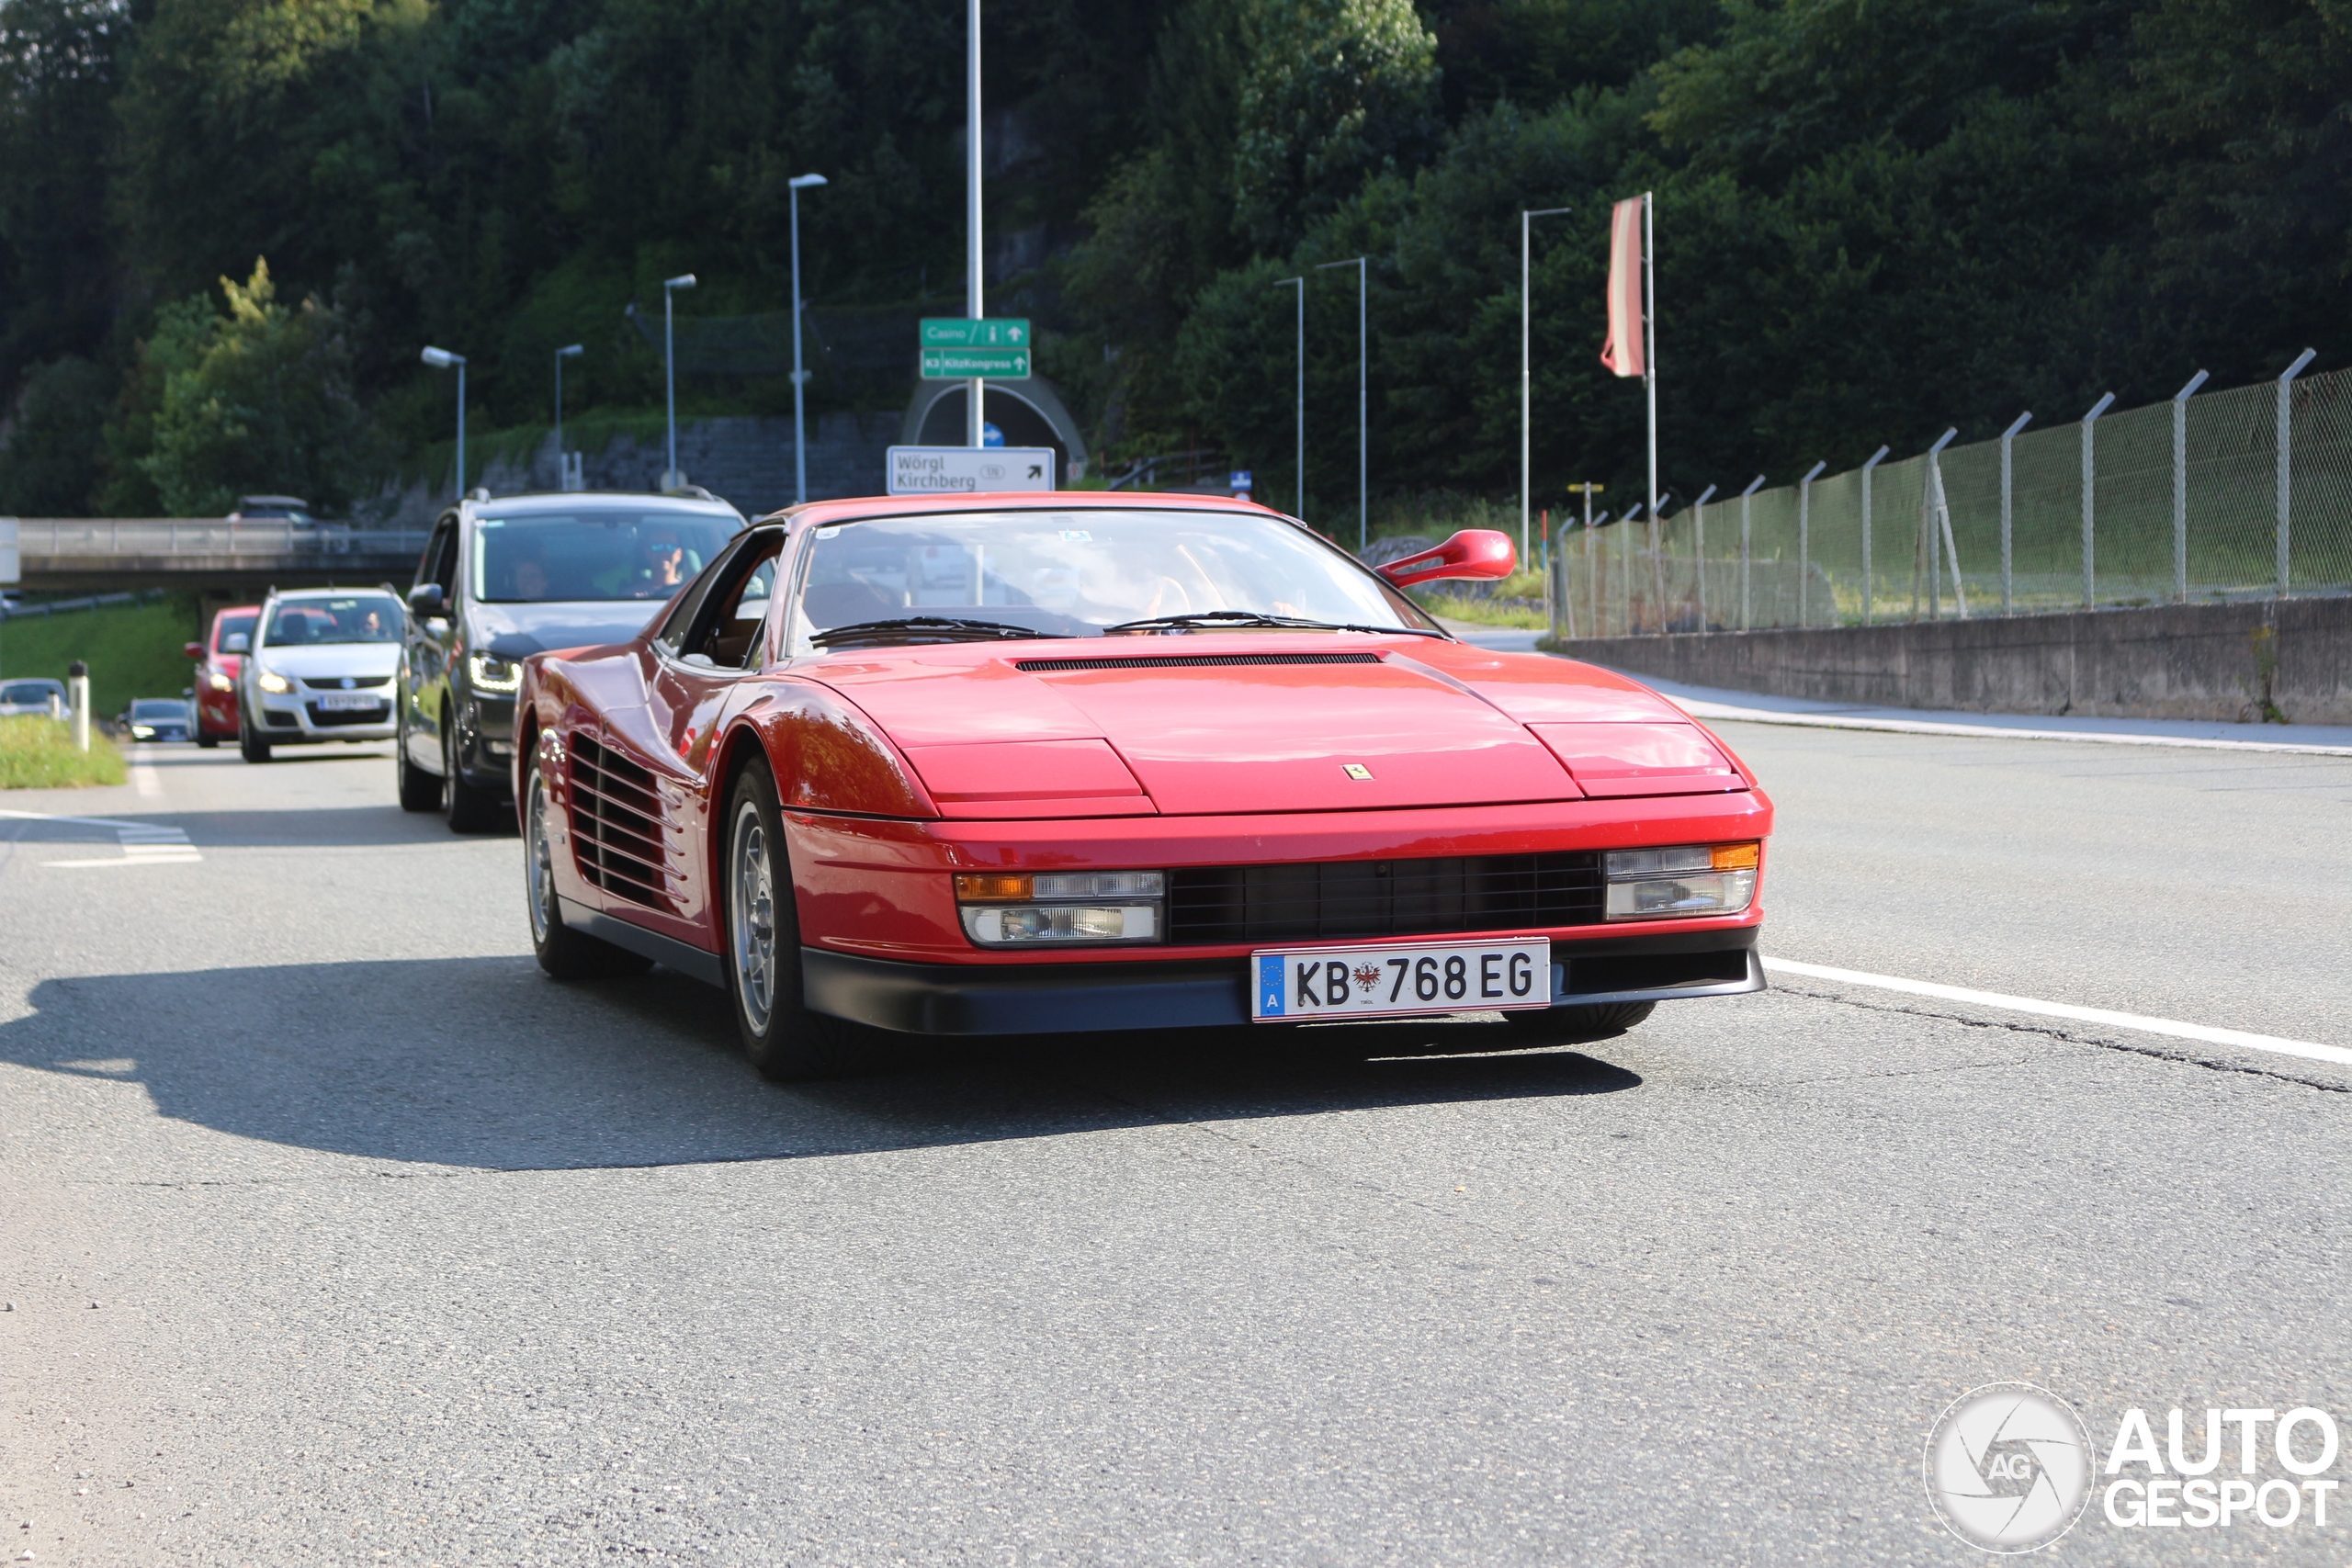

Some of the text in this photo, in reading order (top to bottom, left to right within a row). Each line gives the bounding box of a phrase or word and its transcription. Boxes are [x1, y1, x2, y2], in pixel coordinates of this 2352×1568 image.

[927, 326, 966, 339] Casino
[925, 357, 1012, 371] K3 KitzKongress
[898, 454, 944, 473] Wörgl
[898, 472, 976, 492] Kirchberg
[1296, 952, 1532, 1008] KB 768 EG
[1266, 994, 1279, 1008] A
